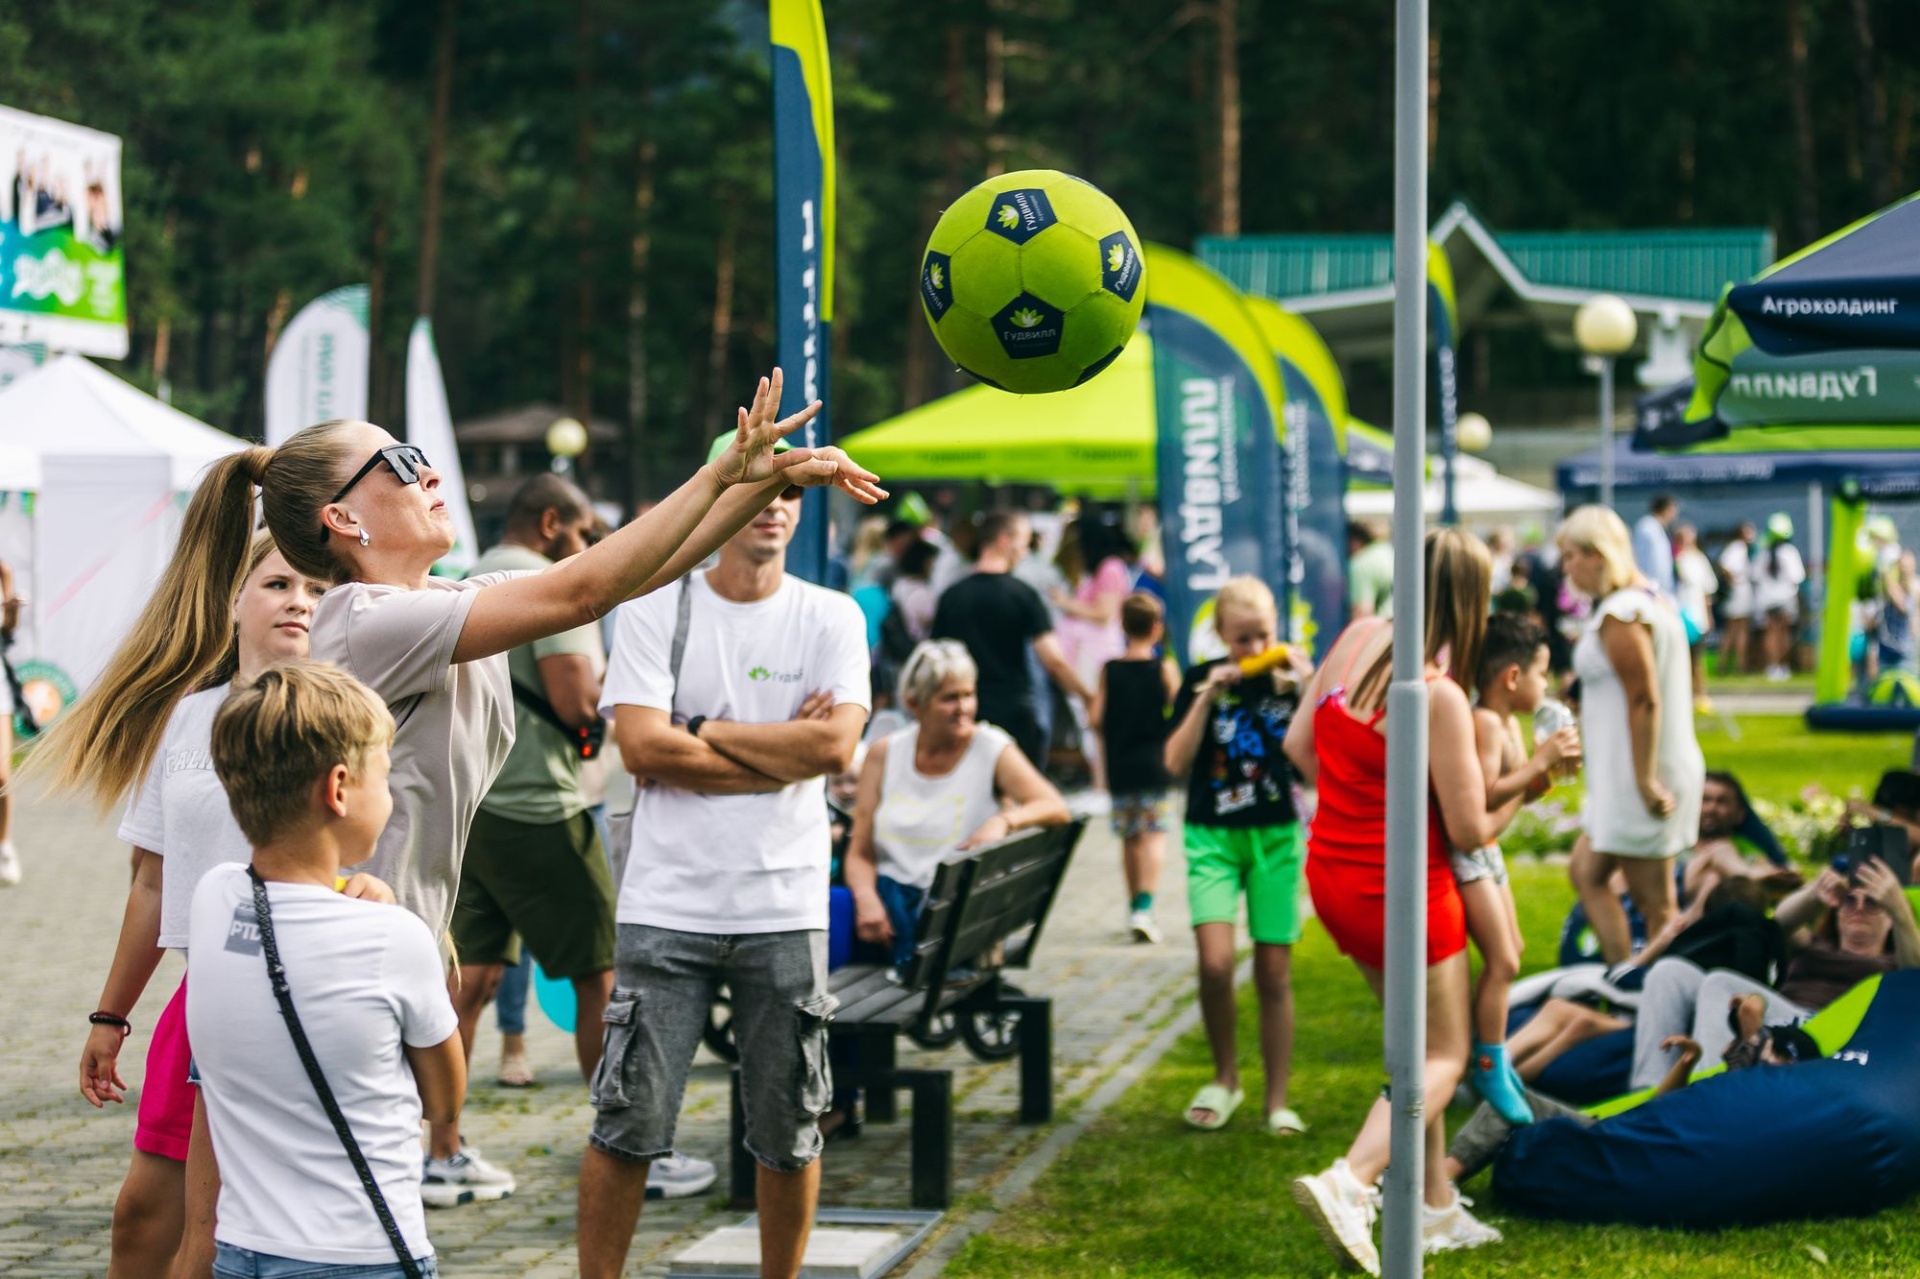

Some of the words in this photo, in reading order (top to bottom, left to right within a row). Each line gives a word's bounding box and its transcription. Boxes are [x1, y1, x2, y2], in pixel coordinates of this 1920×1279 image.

[1014, 192, 1038, 231] Гудвилл
[1762, 296, 1898, 317] Агрохолдинг
[1003, 328, 1056, 341] Гудвилл
